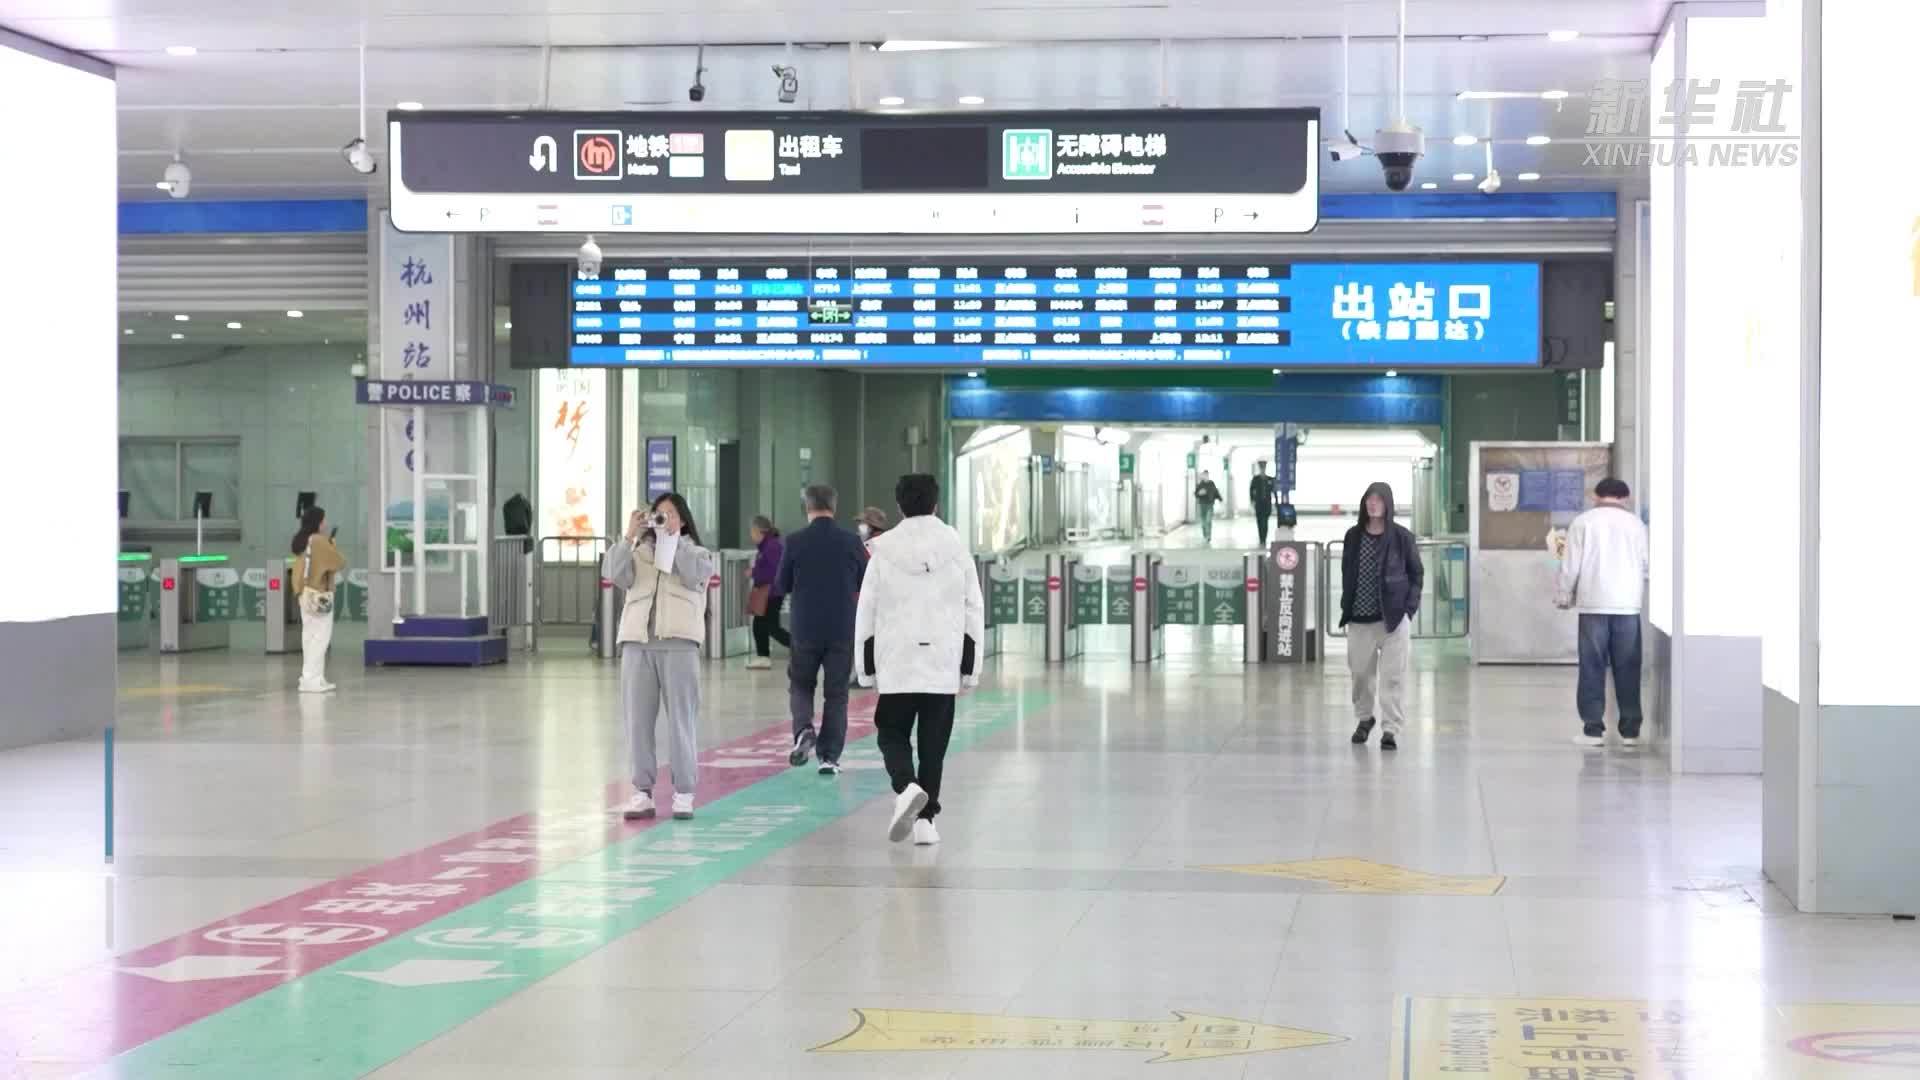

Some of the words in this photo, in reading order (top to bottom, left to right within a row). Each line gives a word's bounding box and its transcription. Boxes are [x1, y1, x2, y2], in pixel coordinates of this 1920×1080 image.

[626, 134, 670, 158] 地铁
[779, 134, 844, 158] 出租车
[1056, 133, 1167, 158] 无障碍电梯
[400, 256, 433, 369] 杭州站
[1332, 281, 1491, 320] 出站口
[387, 384, 452, 401] POLICE
[455, 383, 471, 402] 察
[1277, 573, 1294, 657] 禁止反向进站
